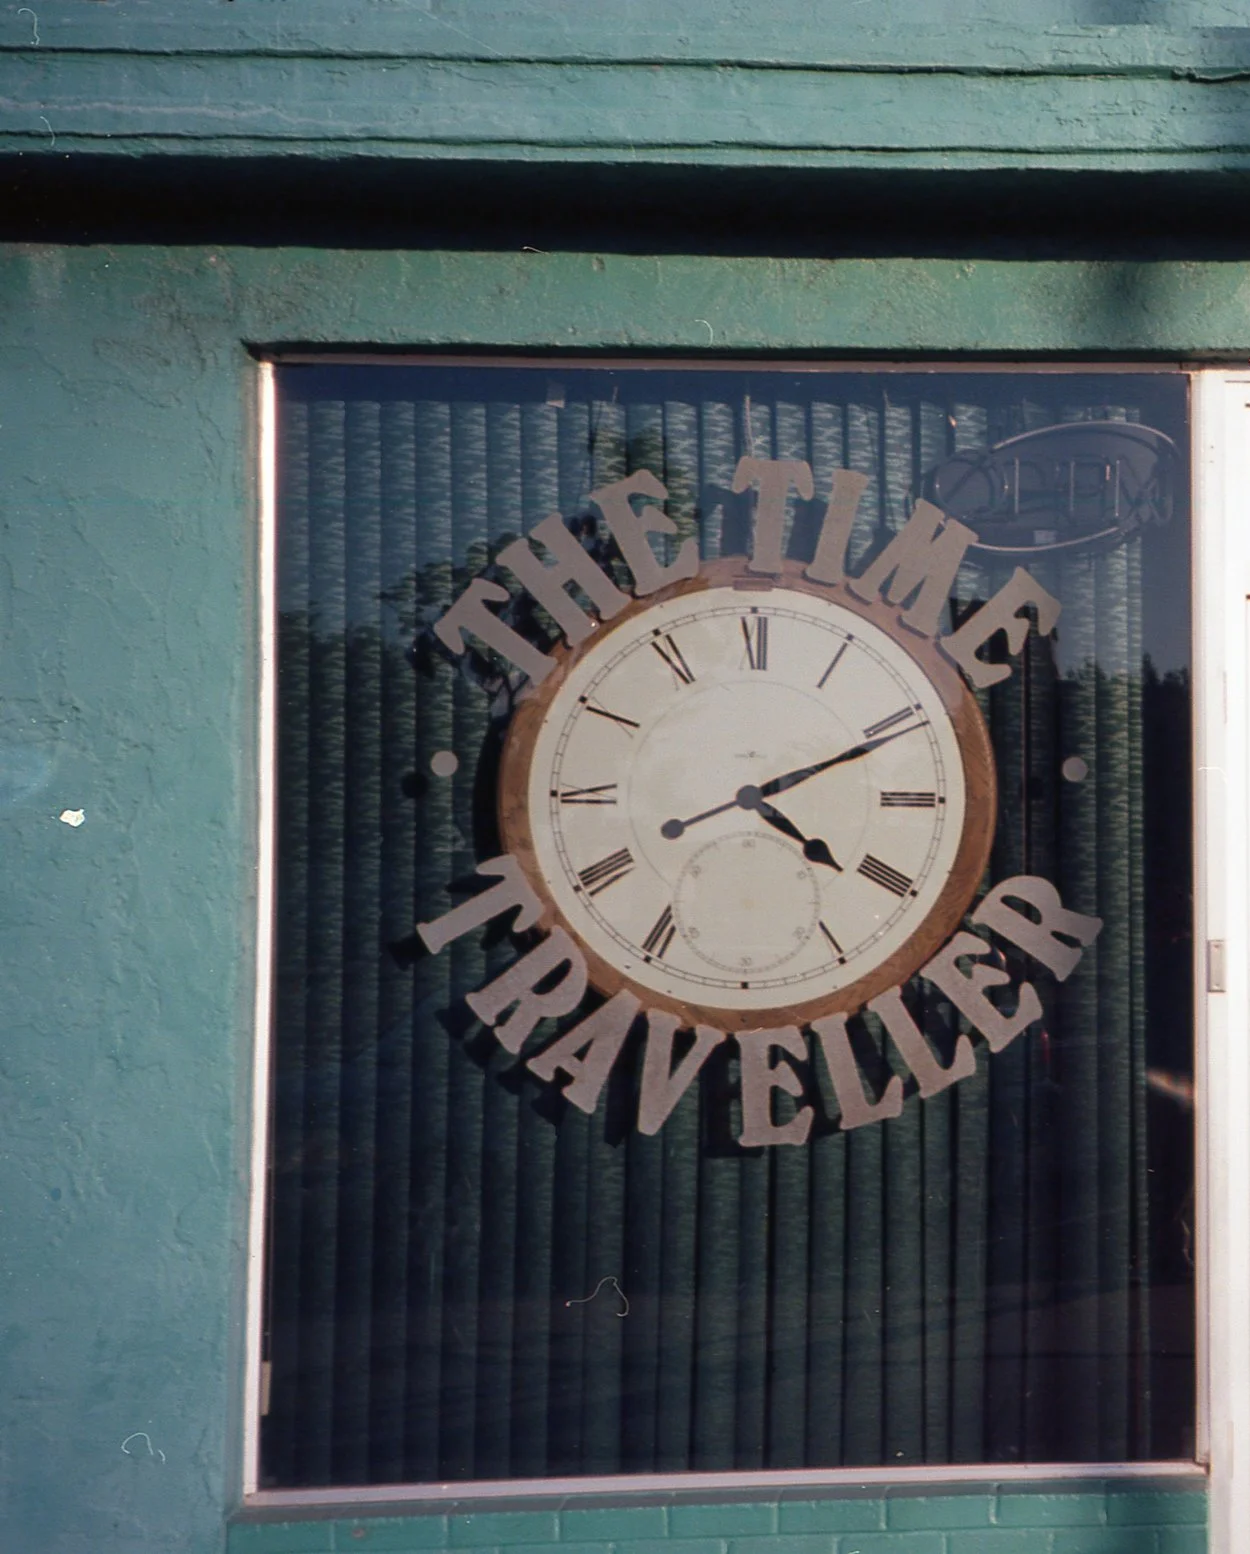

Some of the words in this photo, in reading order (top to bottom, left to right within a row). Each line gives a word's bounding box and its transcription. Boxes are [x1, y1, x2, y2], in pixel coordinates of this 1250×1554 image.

[433, 469, 699, 690] THE
[732, 456, 1062, 689] TIME
[651, 634, 696, 691] XI
[738, 616, 768, 671] XII
[863, 706, 914, 739] II
[560, 783, 618, 804] IX
[880, 791, 936, 808] III
[857, 854, 913, 898] IIII
[417, 853, 1103, 1147] TRAVELLER
